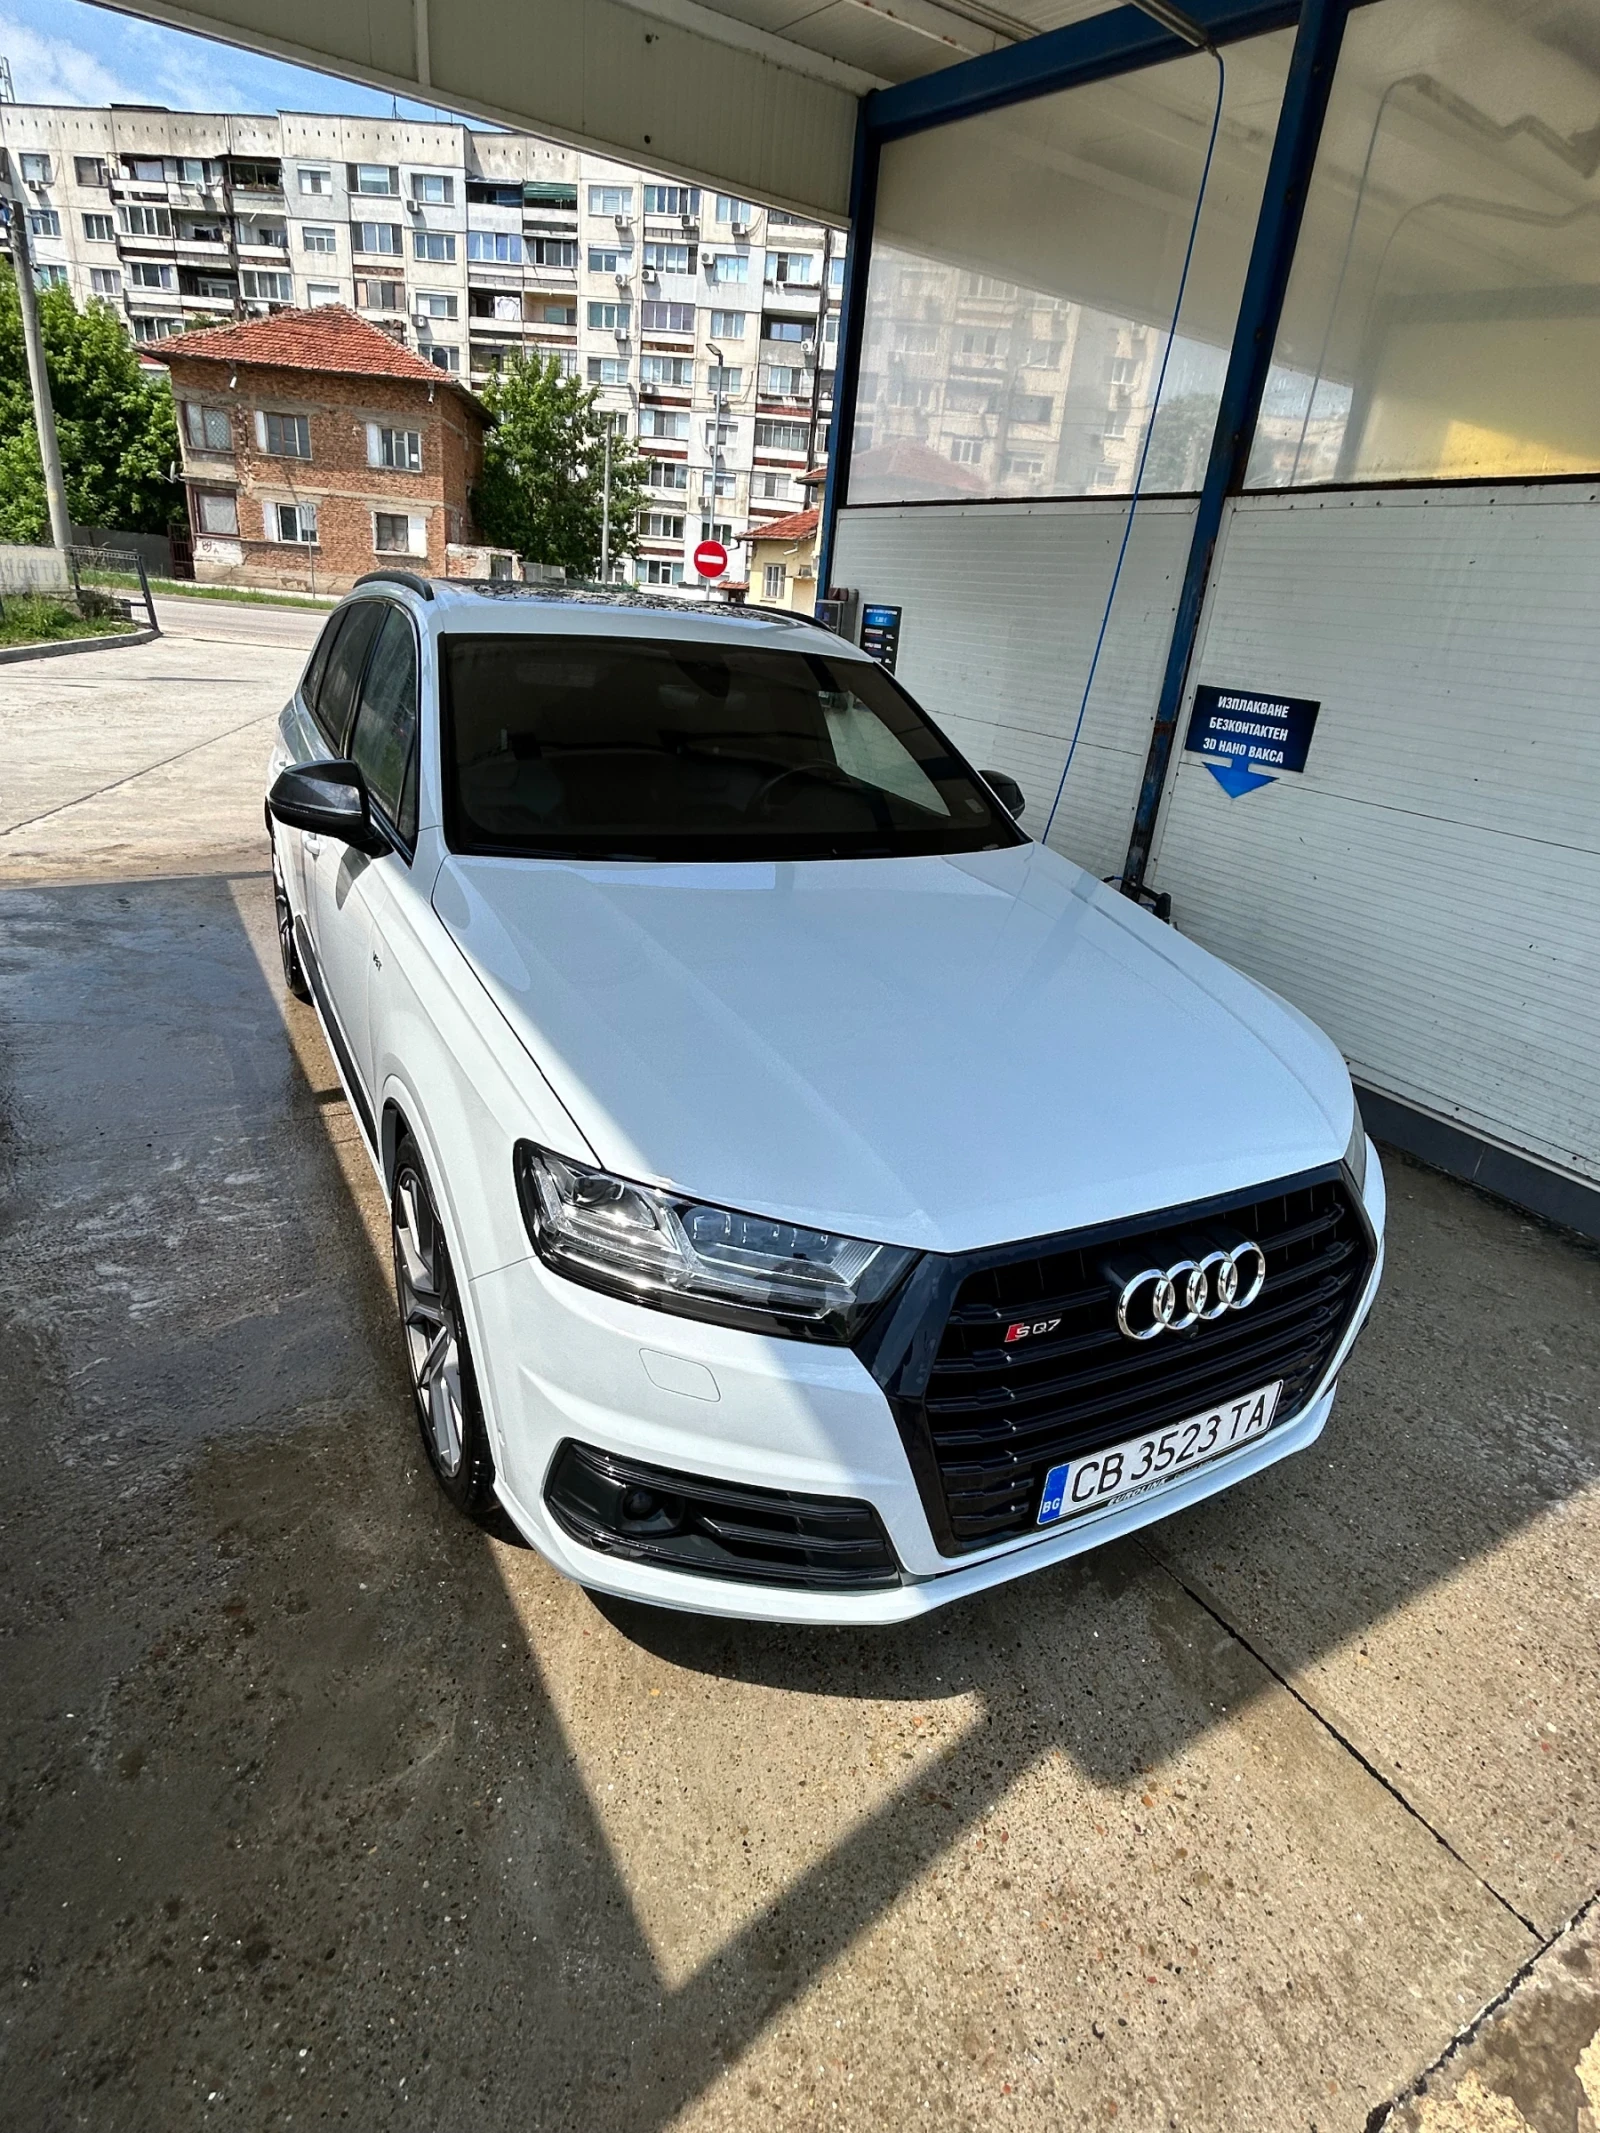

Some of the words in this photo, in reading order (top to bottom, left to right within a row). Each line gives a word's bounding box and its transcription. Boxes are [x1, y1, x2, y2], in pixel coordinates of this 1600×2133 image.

[1218, 696, 1290, 718] ИЗПЛАКВАНЕ
[1209, 717, 1289, 741] БЕЗКОНТАКТЕН
[1203, 738, 1217, 750] 3D
[1218, 740, 1247, 756] НАНО
[1248, 745, 1284, 764] ВАКСА
[1012, 1318, 1062, 1340] SQ7
[1072, 1452, 1125, 1503] CB
[1130, 1414, 1222, 1481] 3523
[1230, 1393, 1266, 1441] TA
[1041, 1497, 1061, 1515] BG
